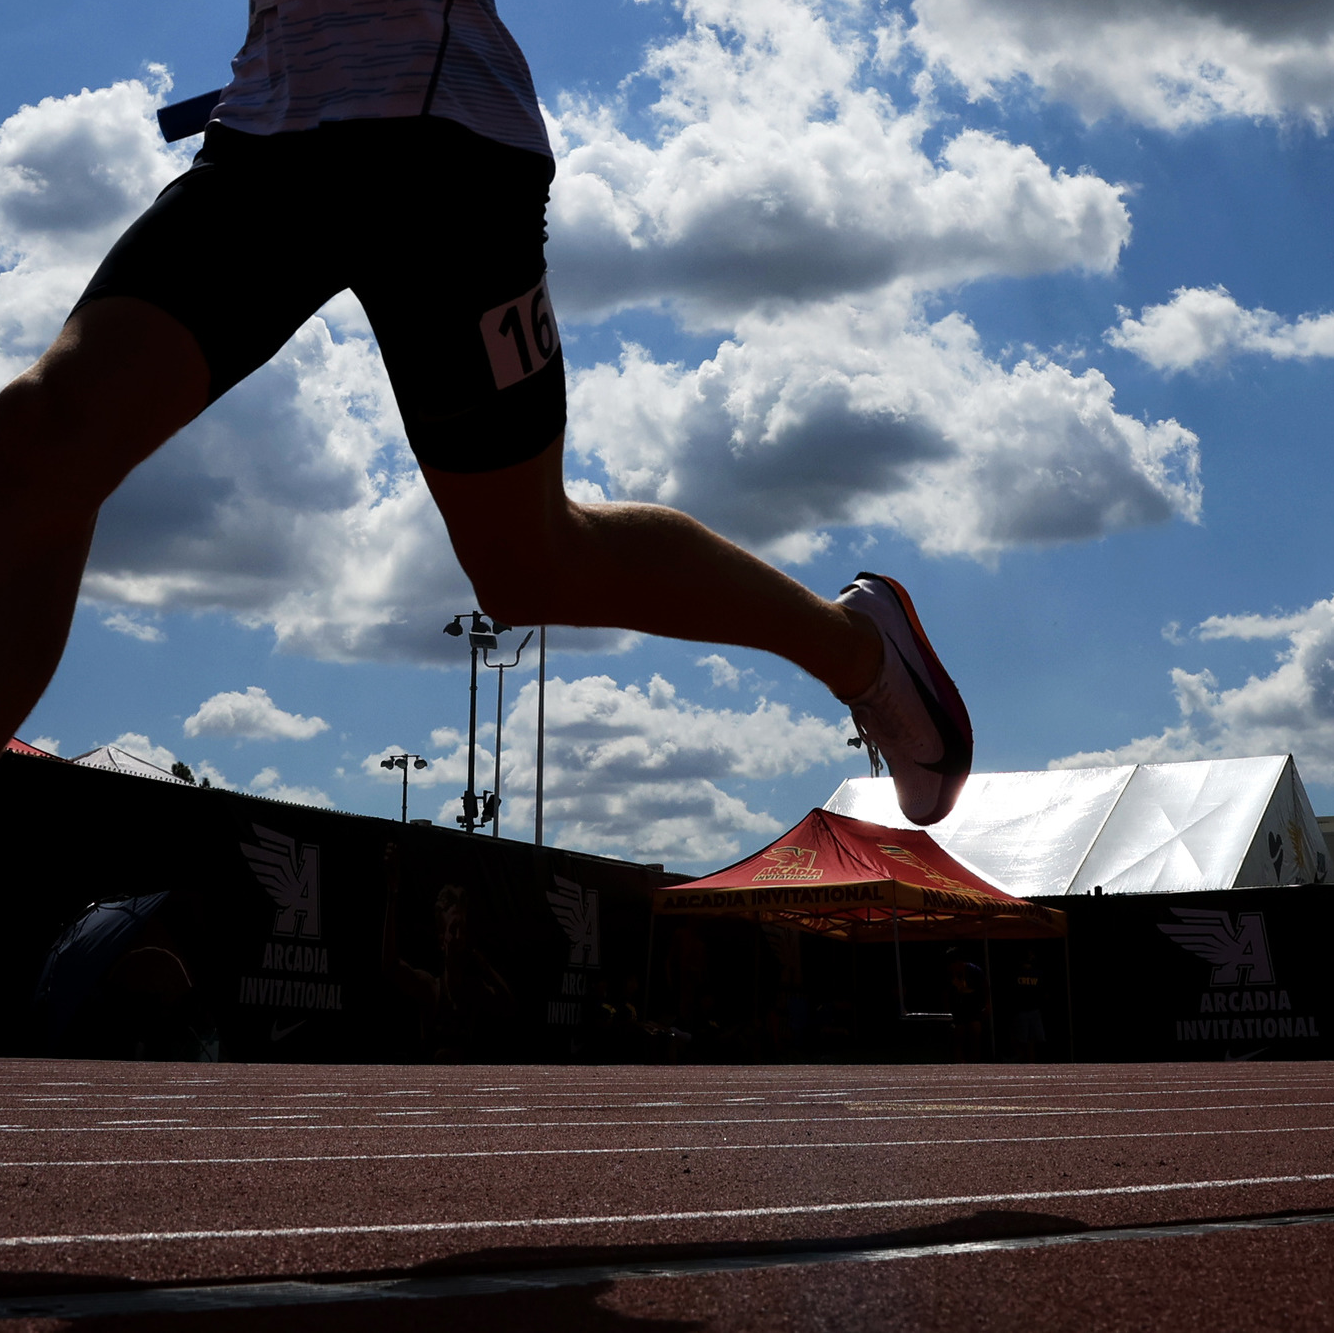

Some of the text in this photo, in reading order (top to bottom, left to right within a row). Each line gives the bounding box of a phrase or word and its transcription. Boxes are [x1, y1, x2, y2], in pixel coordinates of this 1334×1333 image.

[499, 287, 553, 375] 16
[663, 885, 884, 909] ARCADIA INVITATIONAL
[262, 942, 329, 974] ARCADIA
[239, 976, 343, 1010] INVITATIONAL
[1199, 989, 1292, 1013] ARCADIA
[1176, 1016, 1320, 1041] INVITATIONAL
